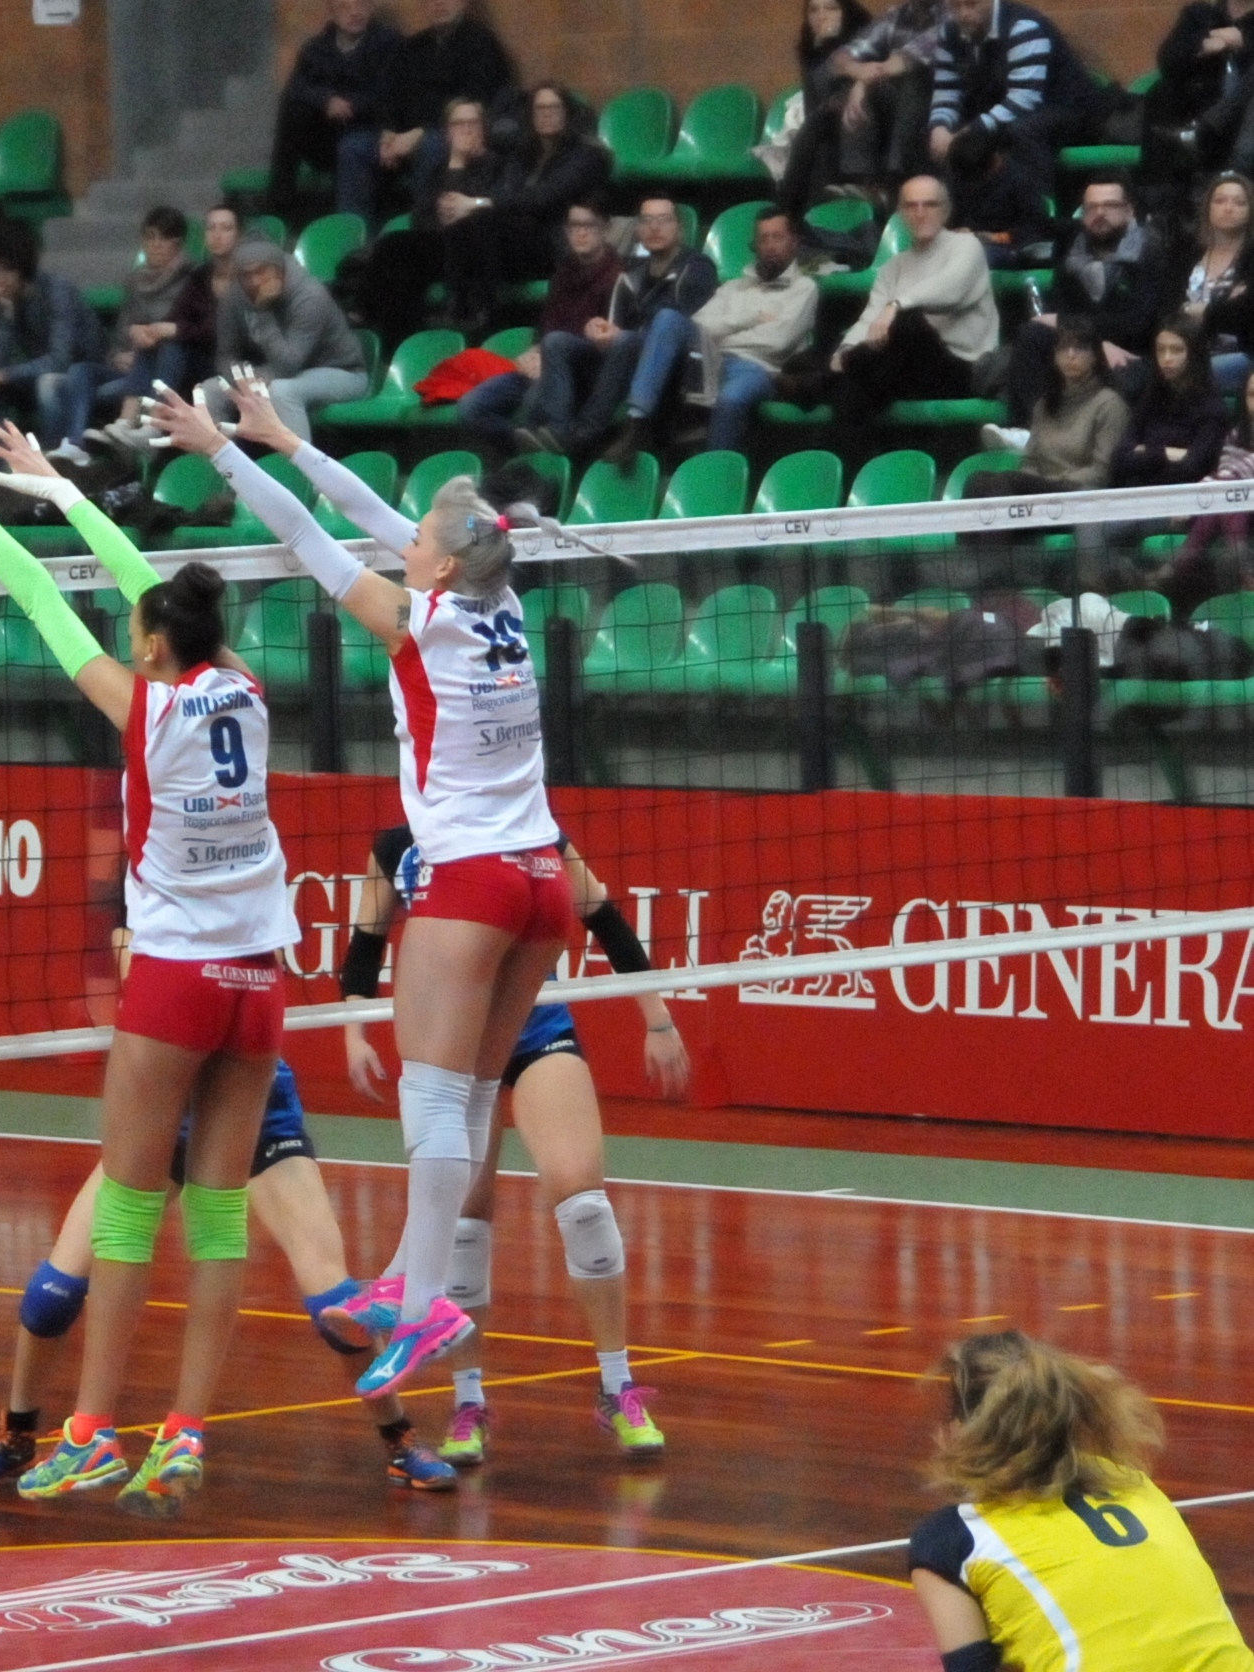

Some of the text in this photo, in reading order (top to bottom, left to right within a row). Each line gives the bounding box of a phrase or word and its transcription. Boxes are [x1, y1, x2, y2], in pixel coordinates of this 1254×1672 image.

[1225, 487, 1251, 502] CEV
[1008, 504, 1034, 518] CEV
[784, 519, 811, 534] CEV
[68, 564, 97, 580] CEV
[209, 715, 248, 788] 9
[184, 797, 214, 813] UBI
[222, 965, 277, 983] GENERALI
[1063, 1479, 1149, 1548] 6
